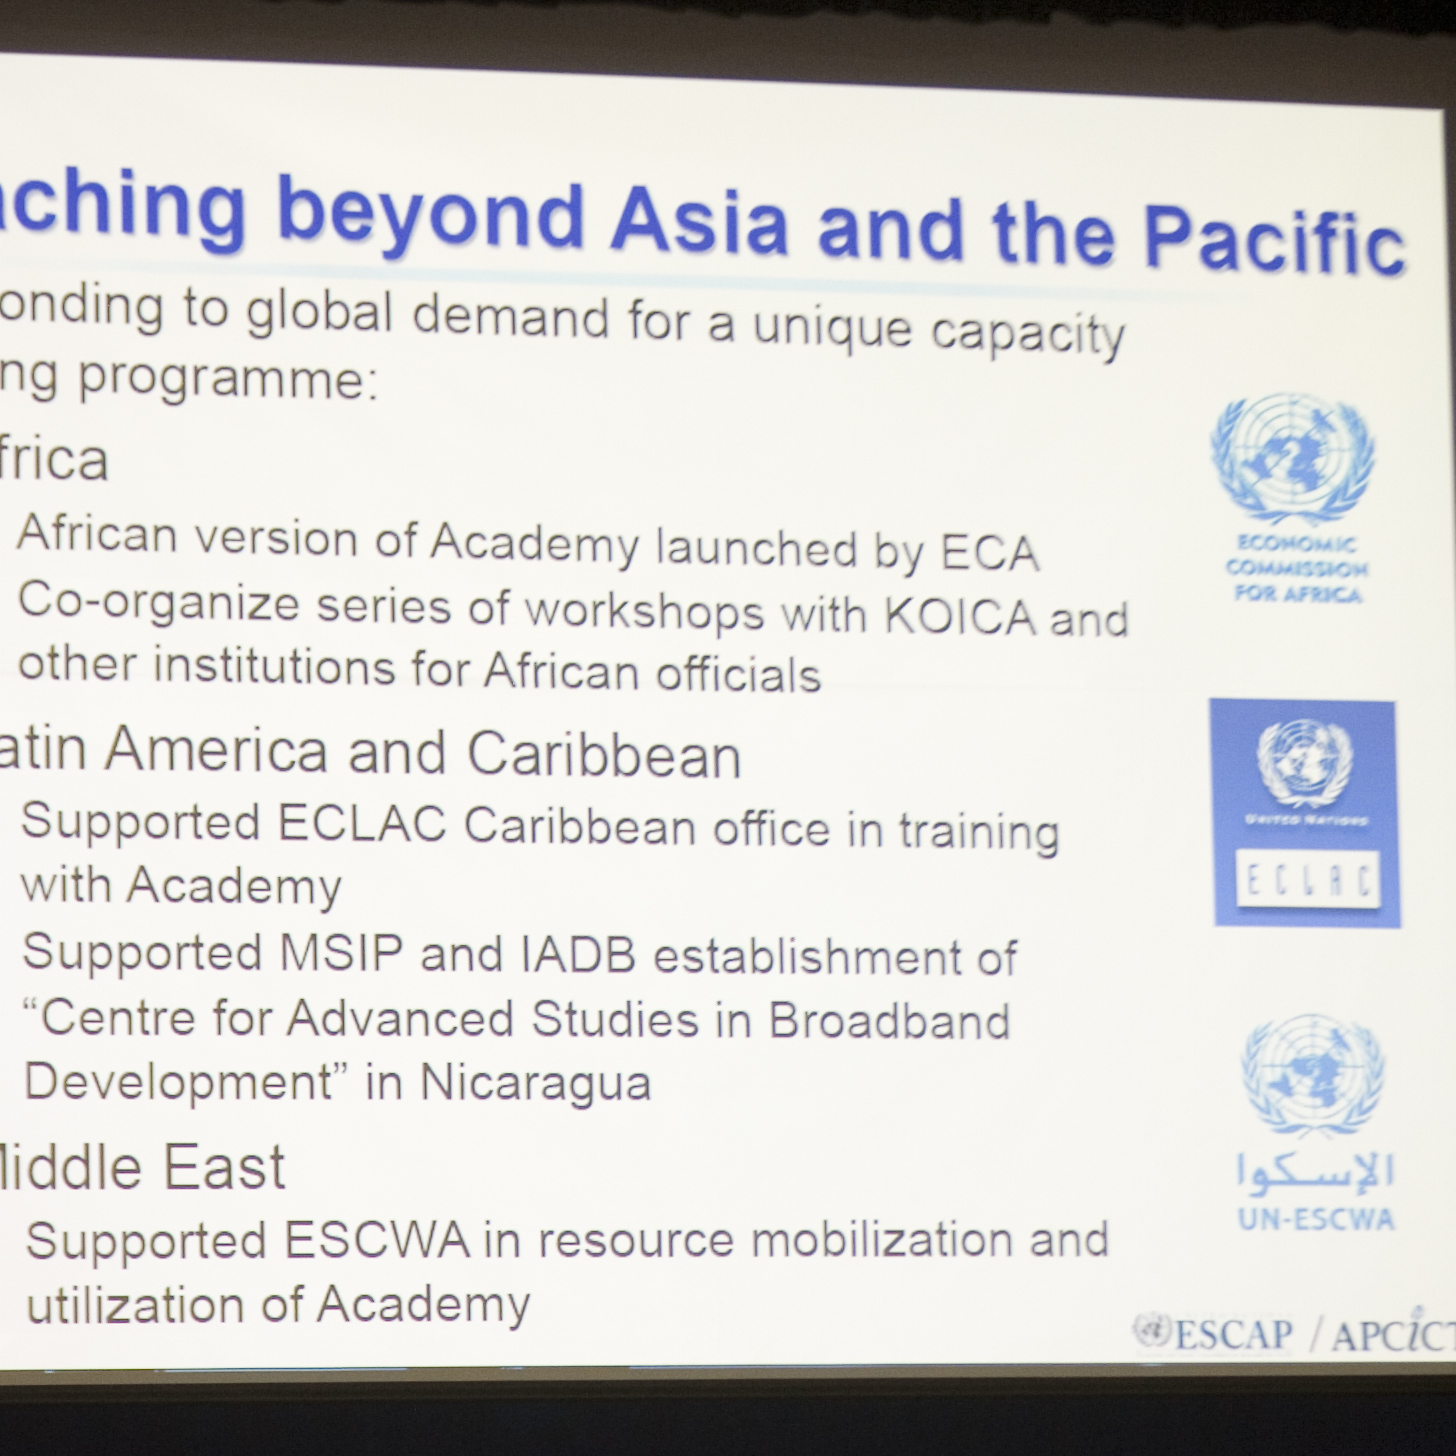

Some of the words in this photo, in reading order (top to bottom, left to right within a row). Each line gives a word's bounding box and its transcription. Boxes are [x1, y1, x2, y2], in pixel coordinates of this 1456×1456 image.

[277, 171, 585, 263] beyond
[608, 183, 790, 258] Asia
[817, 195, 965, 264] and
[990, 198, 1117, 269] the
[1144, 203, 1407, 279] Pacific
[181, 284, 230, 328] to
[245, 285, 393, 342] global
[412, 290, 610, 340] demand
[626, 296, 693, 342] for
[707, 310, 736, 344] a
[753, 303, 913, 359] unique
[930, 313, 1127, 367] capacity
[78, 360, 378, 408] programme:
[14, 510, 178, 554] African
[193, 517, 358, 558] version
[374, 519, 420, 559] of
[428, 519, 641, 574] Academy
[656, 525, 858, 569] launched
[874, 530, 925, 580] by
[941, 531, 1041, 573] ECA
[1225, 558, 1369, 578] COMMISSION
[1237, 534, 1358, 553] ECONOMIC
[17, 577, 301, 630] Co-organize
[316, 585, 453, 626] series
[467, 586, 513, 627] of
[523, 589, 766, 641] workshops
[779, 594, 867, 634] with
[884, 595, 1038, 637] KOICA
[1049, 600, 1129, 639] and
[1235, 584, 1277, 602] FOR
[1283, 586, 1364, 604] AFRICA
[17, 641, 139, 683] other
[153, 645, 397, 687] institutions
[409, 647, 473, 689] for
[481, 649, 640, 692] African
[655, 652, 823, 695] officials
[102, 722, 328, 774] America
[347, 727, 446, 776] and
[467, 727, 742, 780] Caribbean
[20, 798, 261, 851] Supported
[278, 801, 447, 844] ECLAC
[463, 804, 697, 847] Caribbean
[712, 807, 831, 848] office
[847, 809, 884, 849] in
[897, 811, 1060, 861] training
[18, 862, 112, 904] with
[124, 863, 343, 916] Academy
[1248, 863, 1370, 896] ECLAC
[22, 929, 262, 982] Supported
[280, 931, 404, 973] MSIP
[419, 933, 503, 974] and
[521, 933, 637, 975] IADB
[652, 935, 964, 977] establishment
[976, 937, 1020, 977] of
[211, 996, 275, 1038] for
[284, 996, 514, 1039] Advanced
[531, 997, 701, 1039] Studies
[715, 998, 752, 1039] in
[769, 999, 1011, 1041] Broadband
[366, 1060, 403, 1102] in
[420, 1060, 652, 1112] Nicaragua
[164, 1141, 287, 1191] East
[25, 1218, 267, 1271] Supported
[285, 1218, 473, 1260] ESCWA
[483, 1218, 521, 1259] in
[539, 1228, 735, 1259] resource
[751, 1218, 1013, 1259] mobilization
[1029, 1218, 1109, 1258] and
[1238, 1207, 1396, 1231] UN-ESCWA
[26, 1283, 245, 1326] utilization
[260, 1282, 307, 1324] of
[314, 1282, 532, 1333] Academy
[1175, 1319, 1294, 1350] ESCAP
